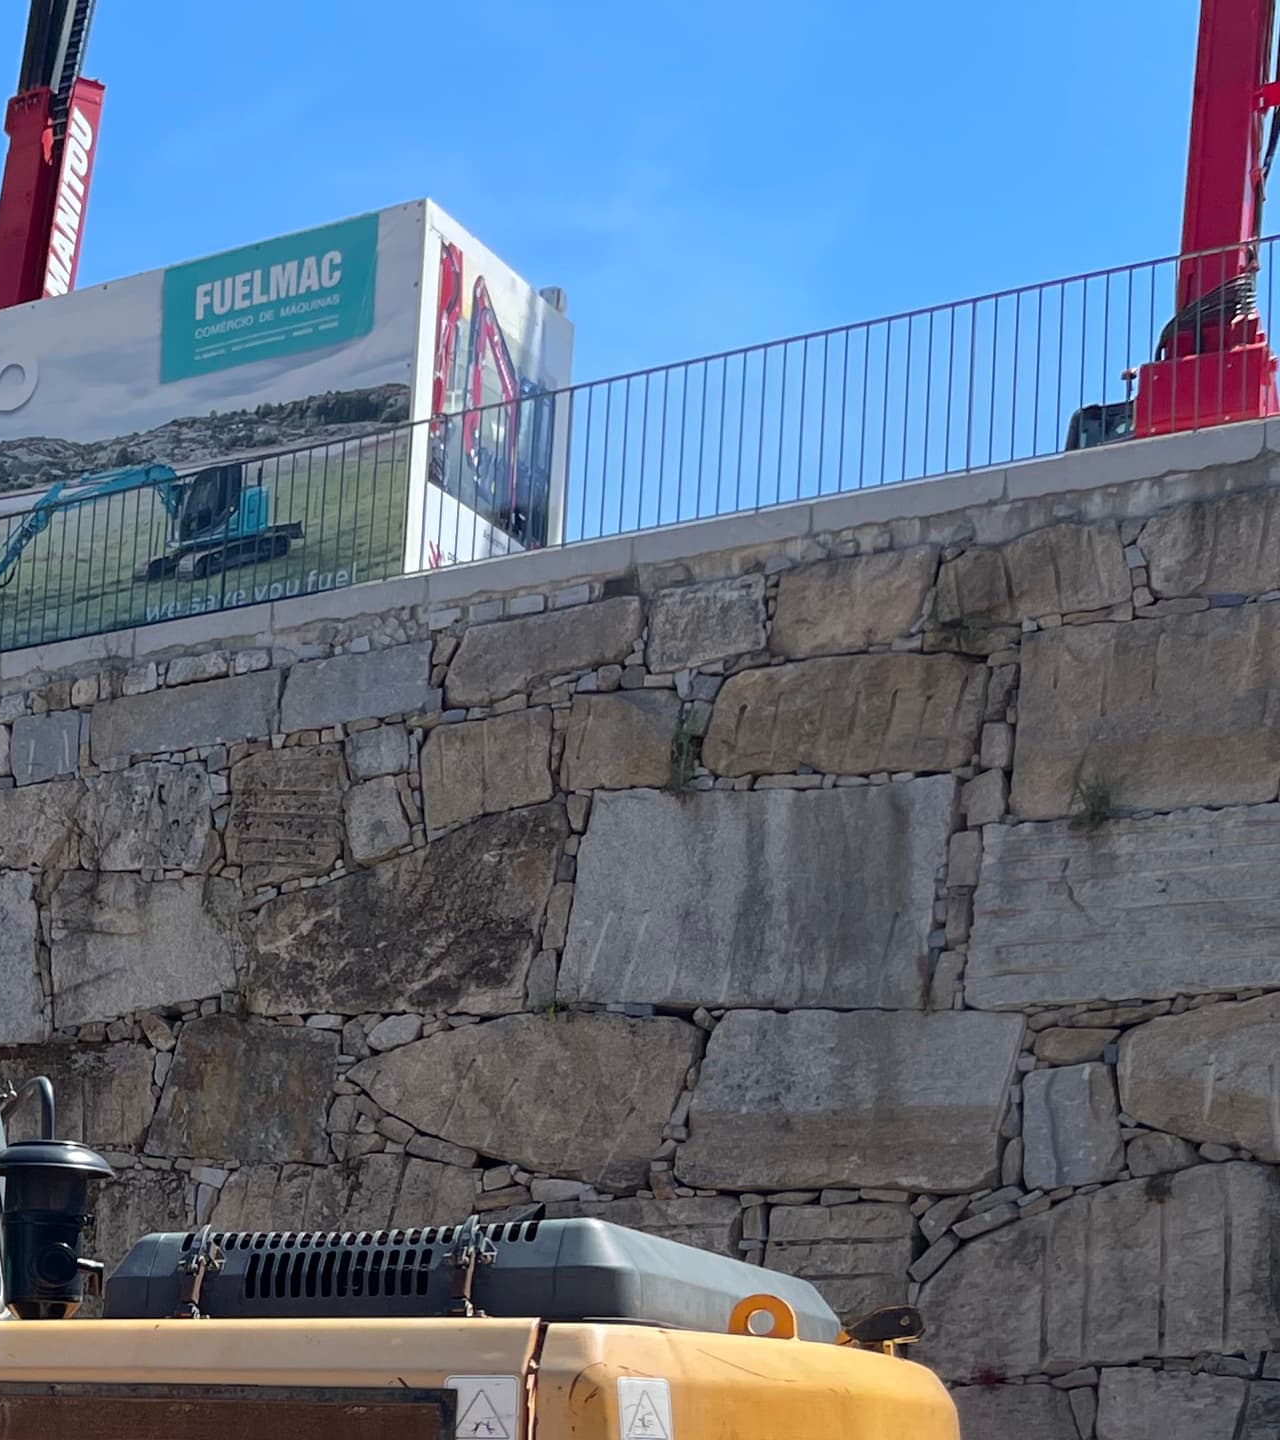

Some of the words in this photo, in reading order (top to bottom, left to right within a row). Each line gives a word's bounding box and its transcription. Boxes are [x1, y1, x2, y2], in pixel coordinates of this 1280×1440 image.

[44, 106, 93, 297] MANITOU
[194, 250, 342, 321] FUELMAC
[194, 314, 254, 340] COMÉRCIO
[258, 309, 275, 323] DE
[254, 579, 299, 602] you
[306, 561, 358, 592] fuel
